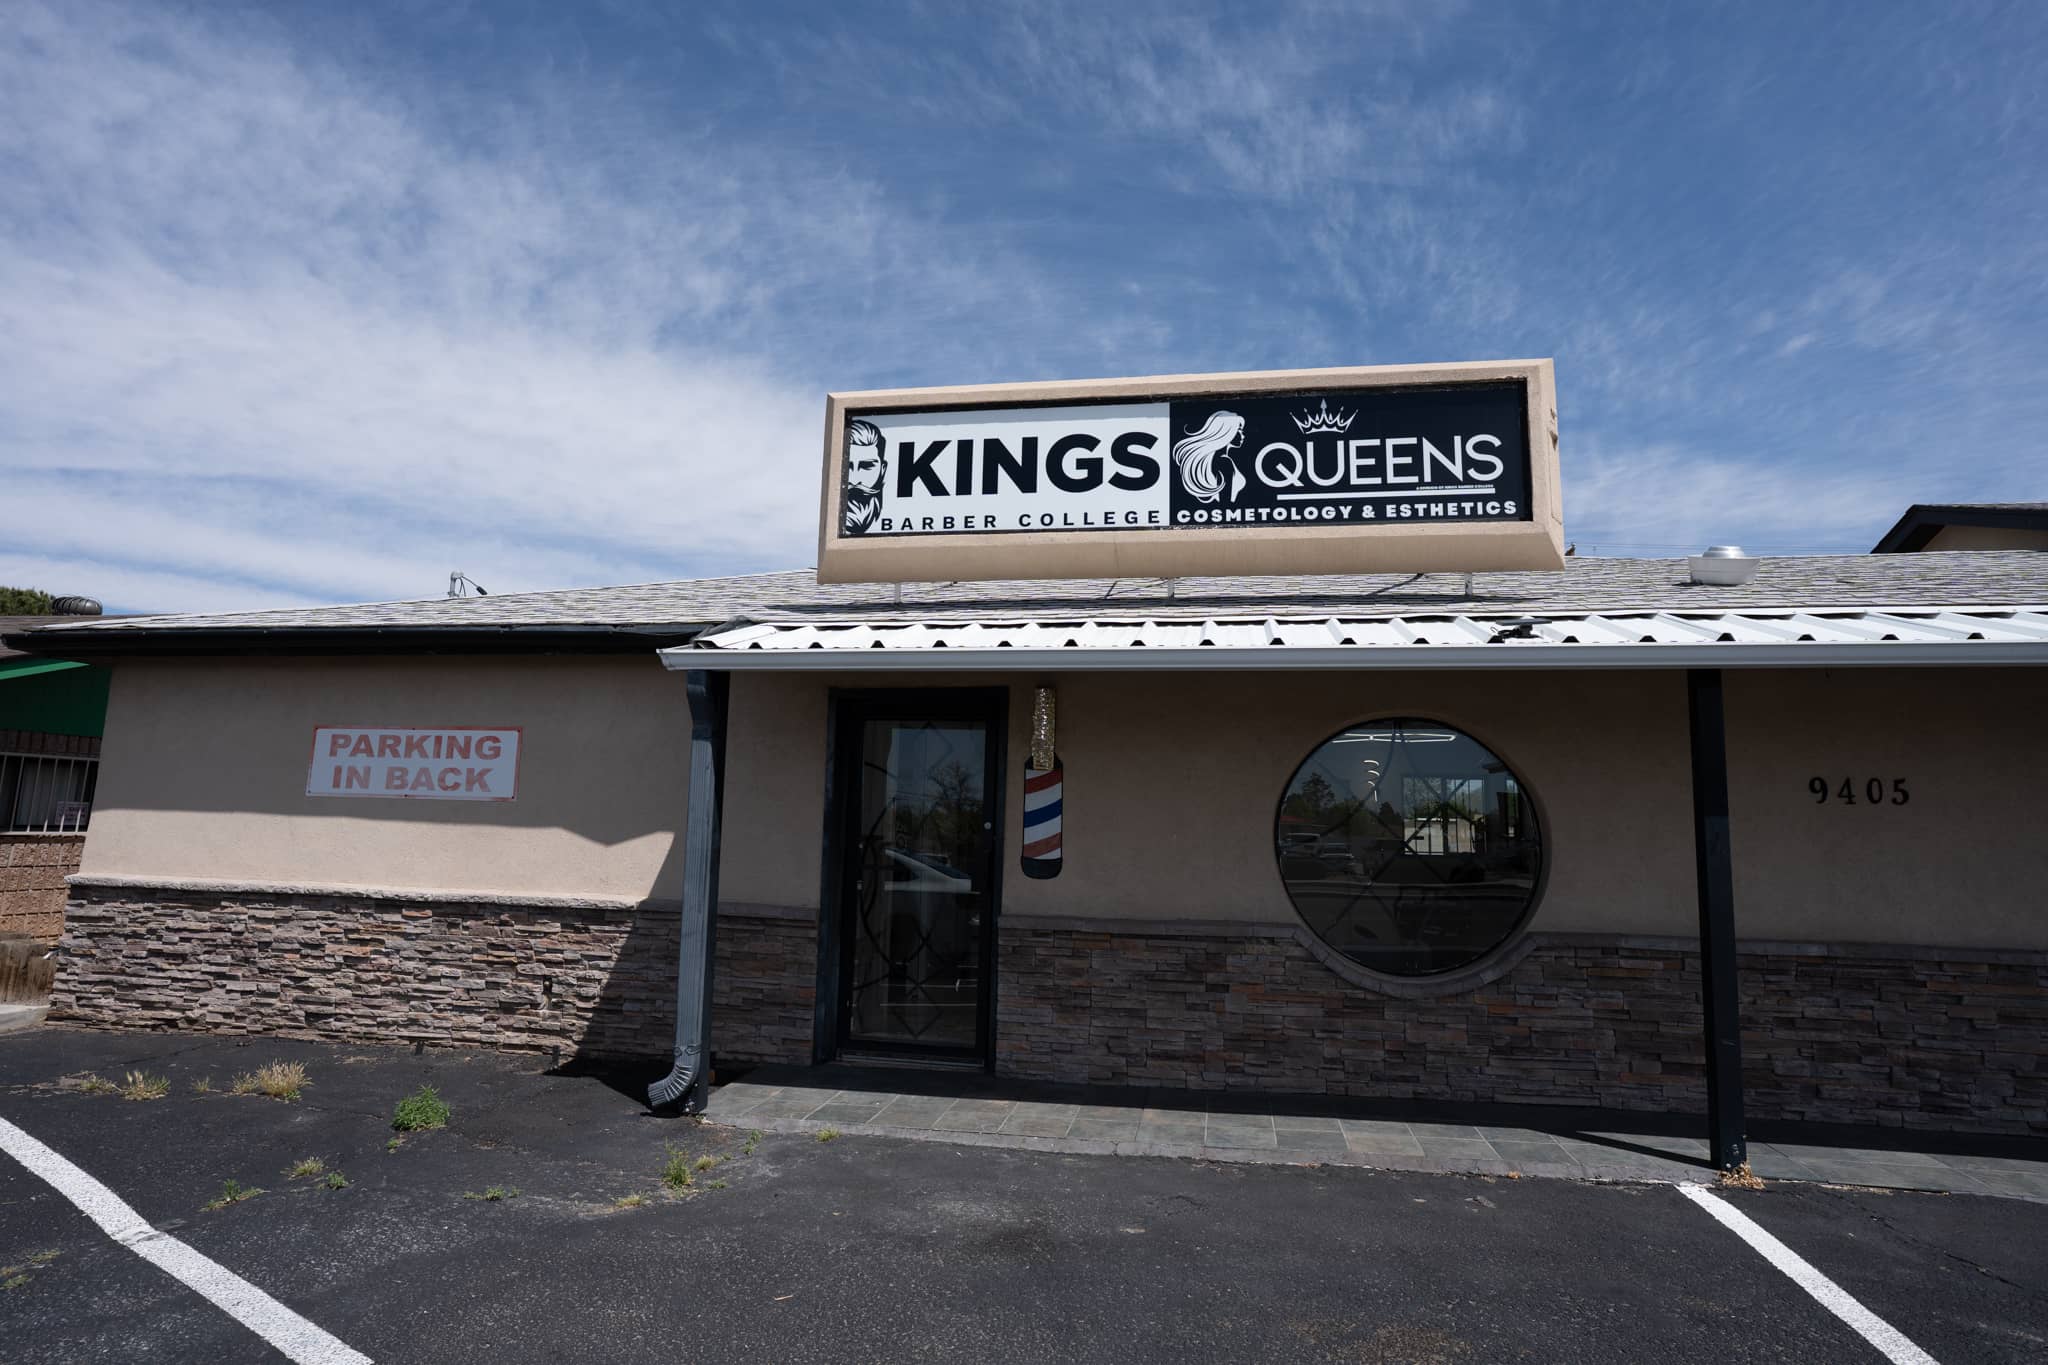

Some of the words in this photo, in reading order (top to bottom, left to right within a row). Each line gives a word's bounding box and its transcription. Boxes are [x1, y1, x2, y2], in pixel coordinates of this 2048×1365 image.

[896, 431, 1161, 498] KINGS
[1254, 433, 1504, 488] QUEENS
[880, 514, 997, 531] BARBER
[1018, 510, 1160, 528] COLLEGE
[1176, 505, 1353, 524] COSMETOLOGY
[1361, 504, 1376, 519] &
[1385, 500, 1517, 518] ESTHETICS
[328, 733, 502, 760] PARKING
[332, 765, 372, 789] IN
[384, 766, 495, 792] BACK
[1808, 776, 1910, 806] 9405
